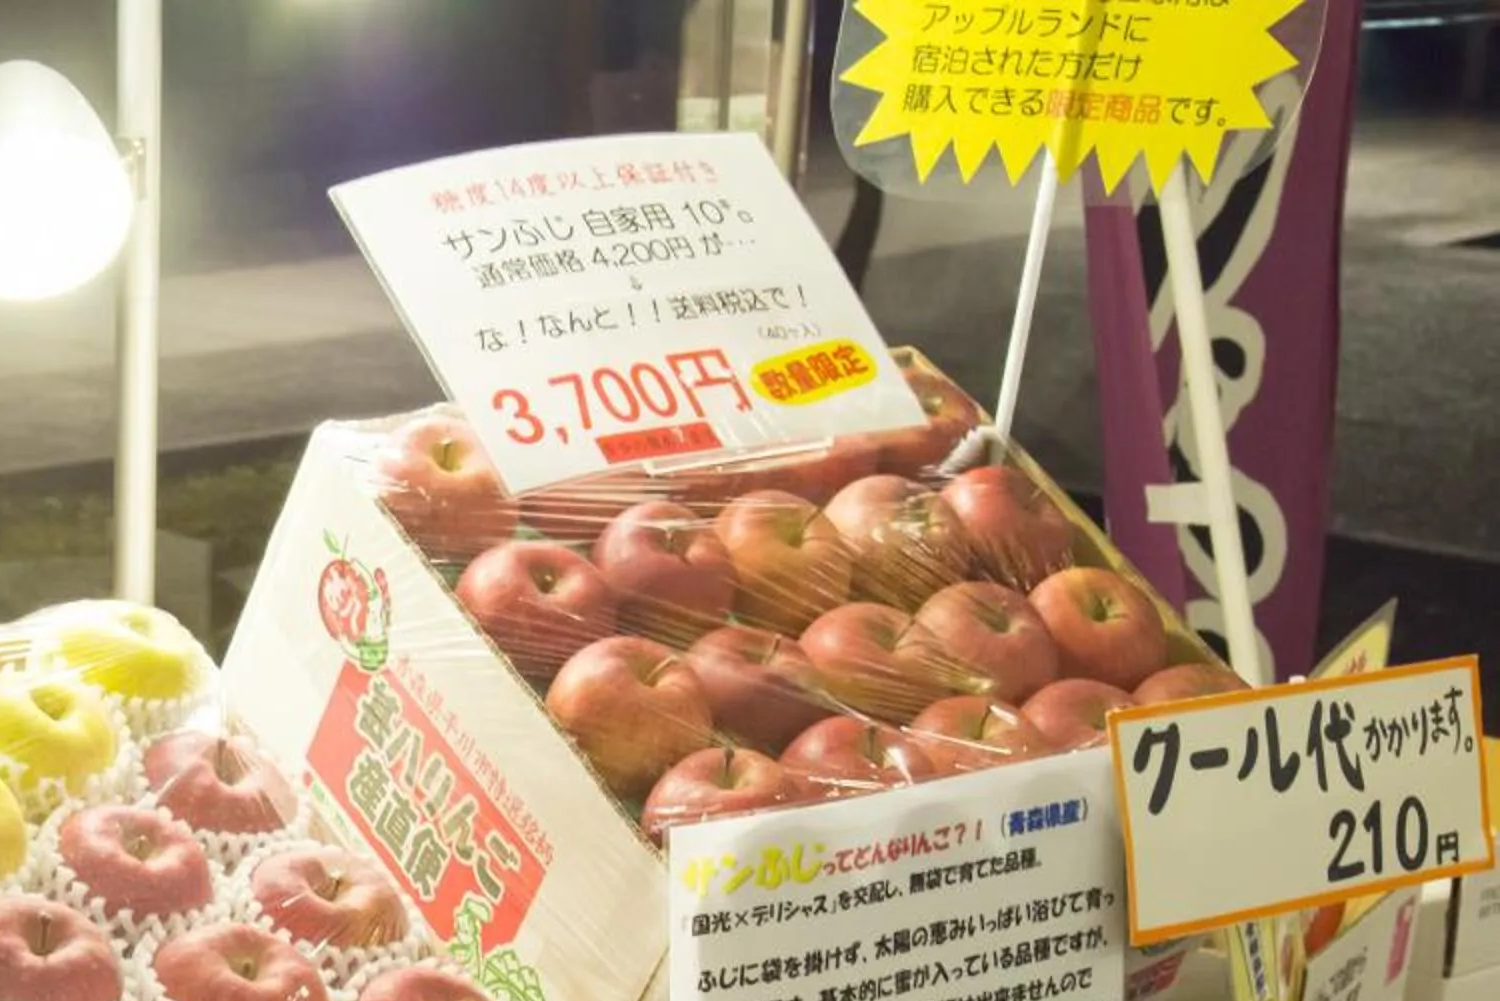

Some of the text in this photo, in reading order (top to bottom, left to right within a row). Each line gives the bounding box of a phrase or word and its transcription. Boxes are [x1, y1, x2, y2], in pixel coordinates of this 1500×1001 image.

[920, 3, 1152, 42] アップルランドに
[912, 44, 1142, 83] 宿泊された方だけ
[902, 83, 1230, 127] 購入できる限定商品です。
[444, 213, 575, 262] サンふじ
[582, 202, 675, 238] 自家用
[473, 247, 585, 290] 通常価格
[492, 348, 753, 448] 3,700円
[759, 345, 869, 401] 数量限定
[1327, 796, 1460, 882] 210円
